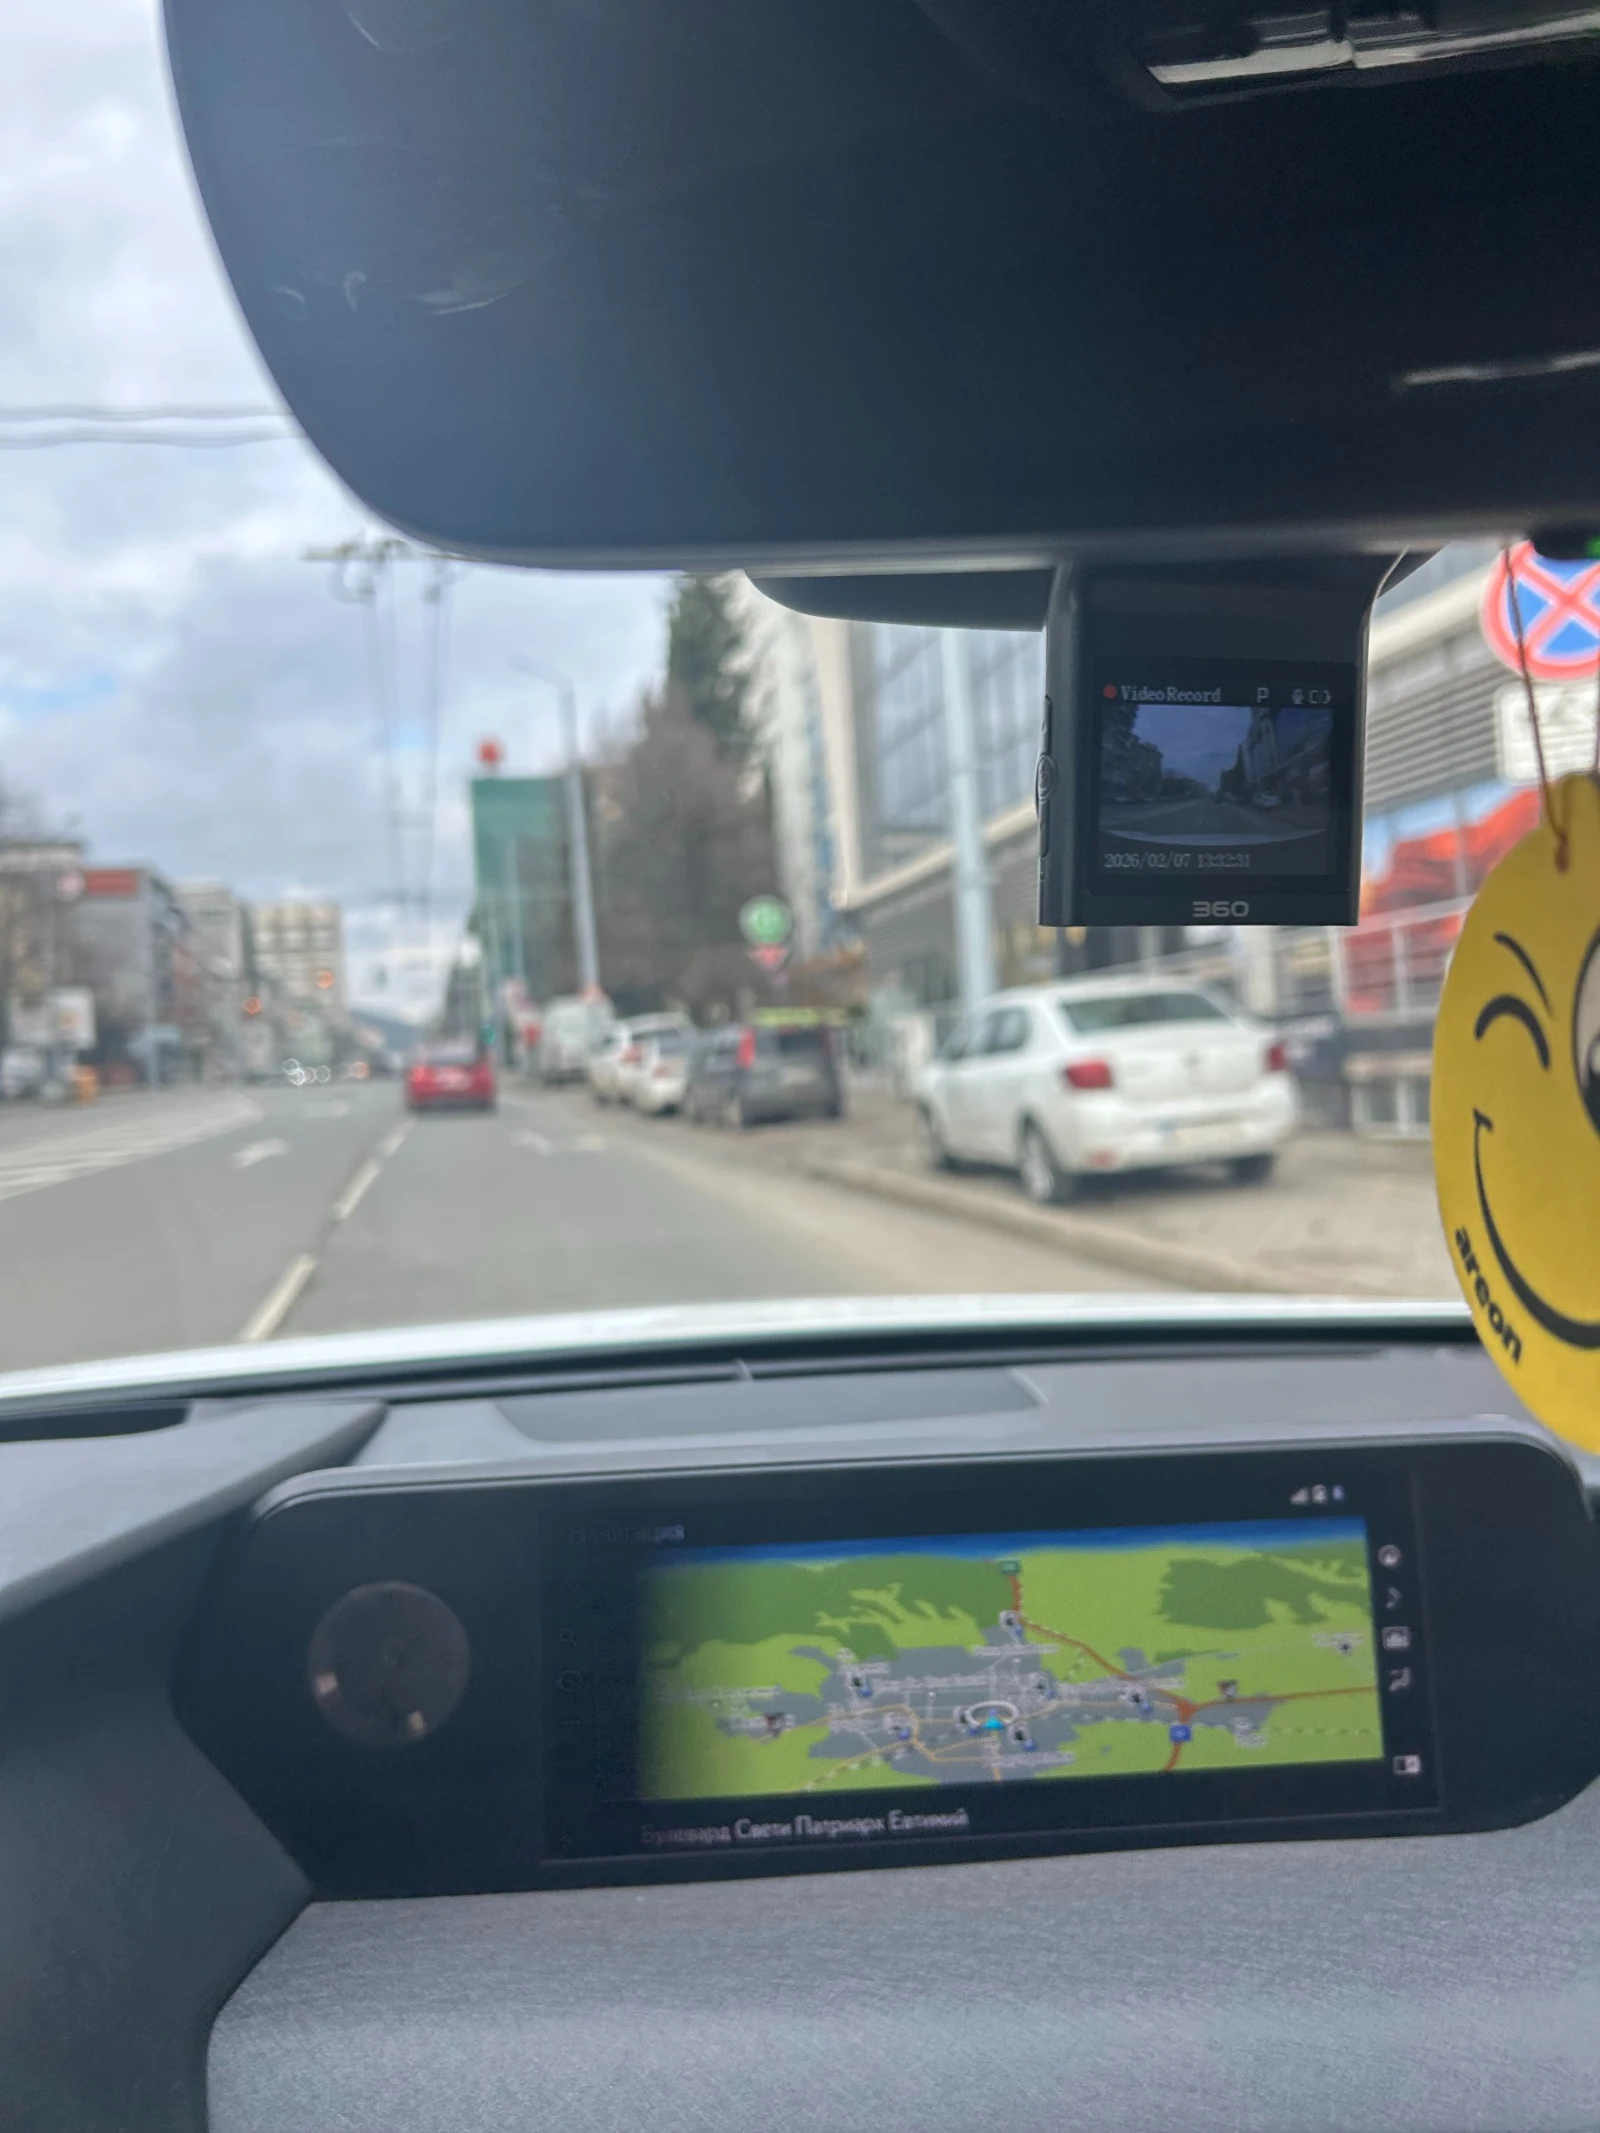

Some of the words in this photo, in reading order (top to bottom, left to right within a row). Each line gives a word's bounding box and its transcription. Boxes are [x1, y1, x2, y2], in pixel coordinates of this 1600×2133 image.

[1104, 851, 1191, 869] 2026/02/07
[1192, 901, 1249, 917] 360
[1455, 1226, 1522, 1366] areon
[734, 1818, 792, 1838] Свети
[794, 1814, 884, 1837] Патриарх
[887, 1808, 970, 1830] Евтимий
